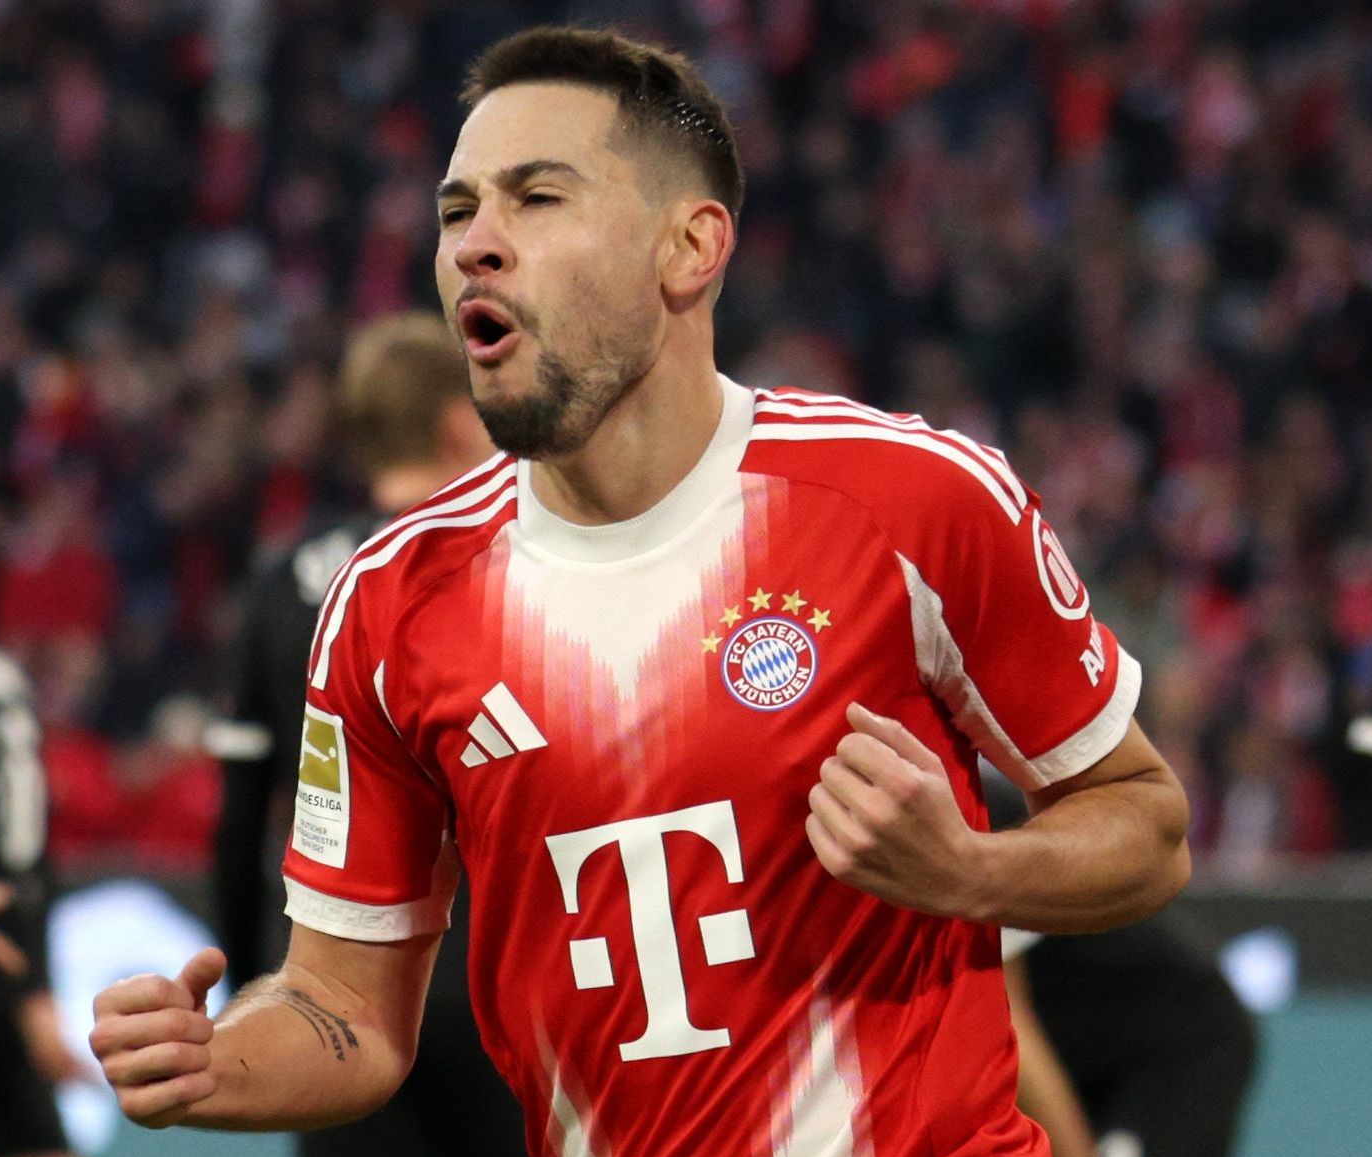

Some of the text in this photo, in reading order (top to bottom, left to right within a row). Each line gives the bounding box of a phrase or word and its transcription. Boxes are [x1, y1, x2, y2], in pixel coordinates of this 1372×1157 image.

[729, 624, 807, 664] FC BAYERN
[733, 667, 810, 704] MÜNCHEN
[545, 800, 755, 1061] T
